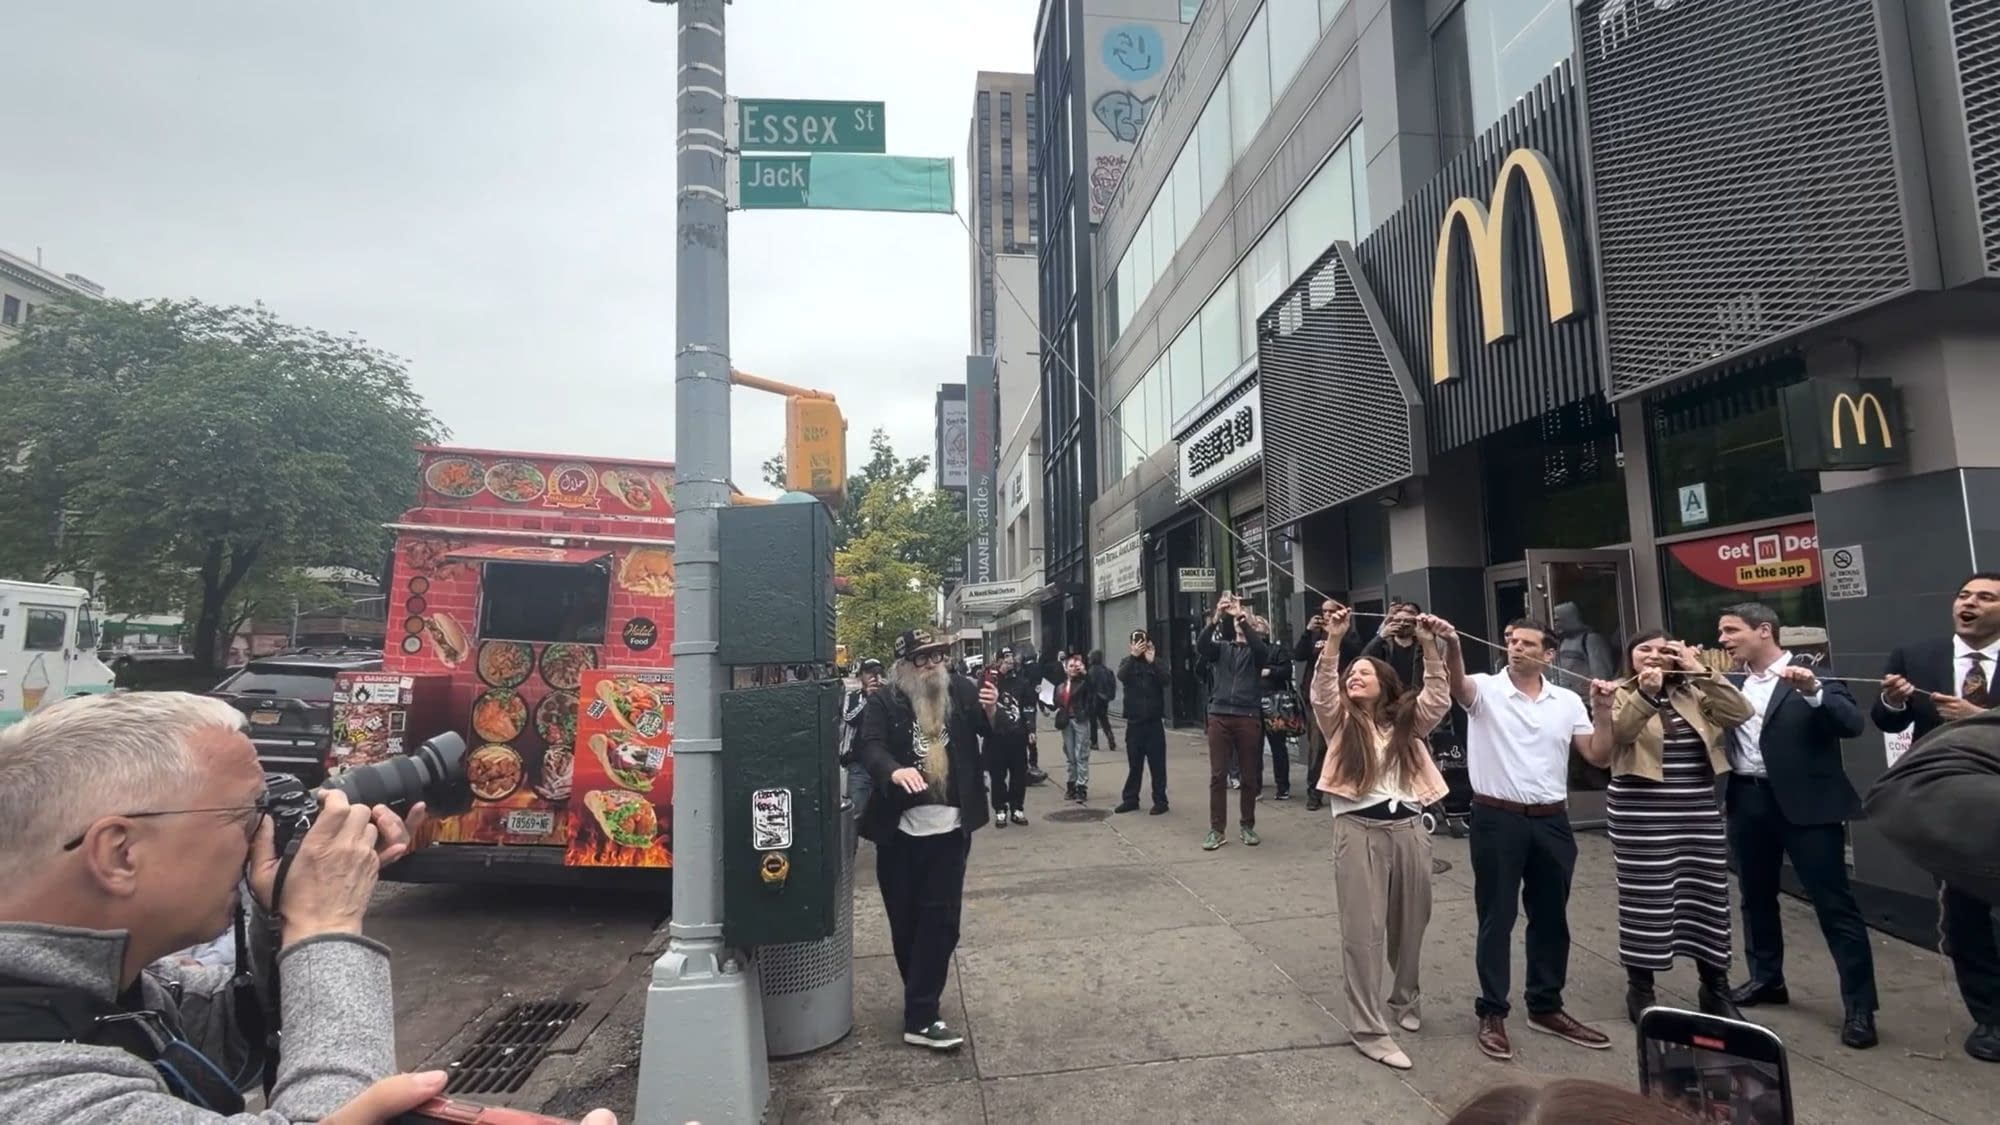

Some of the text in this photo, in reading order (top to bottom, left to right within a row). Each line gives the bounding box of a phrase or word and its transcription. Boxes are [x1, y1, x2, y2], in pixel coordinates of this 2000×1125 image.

[743, 105, 875, 144] Essex St
[747, 161, 805, 187] Jack
[1685, 489, 1702, 512] A
[977, 537, 990, 584] DUANE
[1717, 542, 1750, 561] Get
[1180, 569, 1200, 577] SMOKE
[1740, 563, 1806, 582] in the app
[624, 623, 655, 637] Halal
[630, 637, 649, 646] Food
